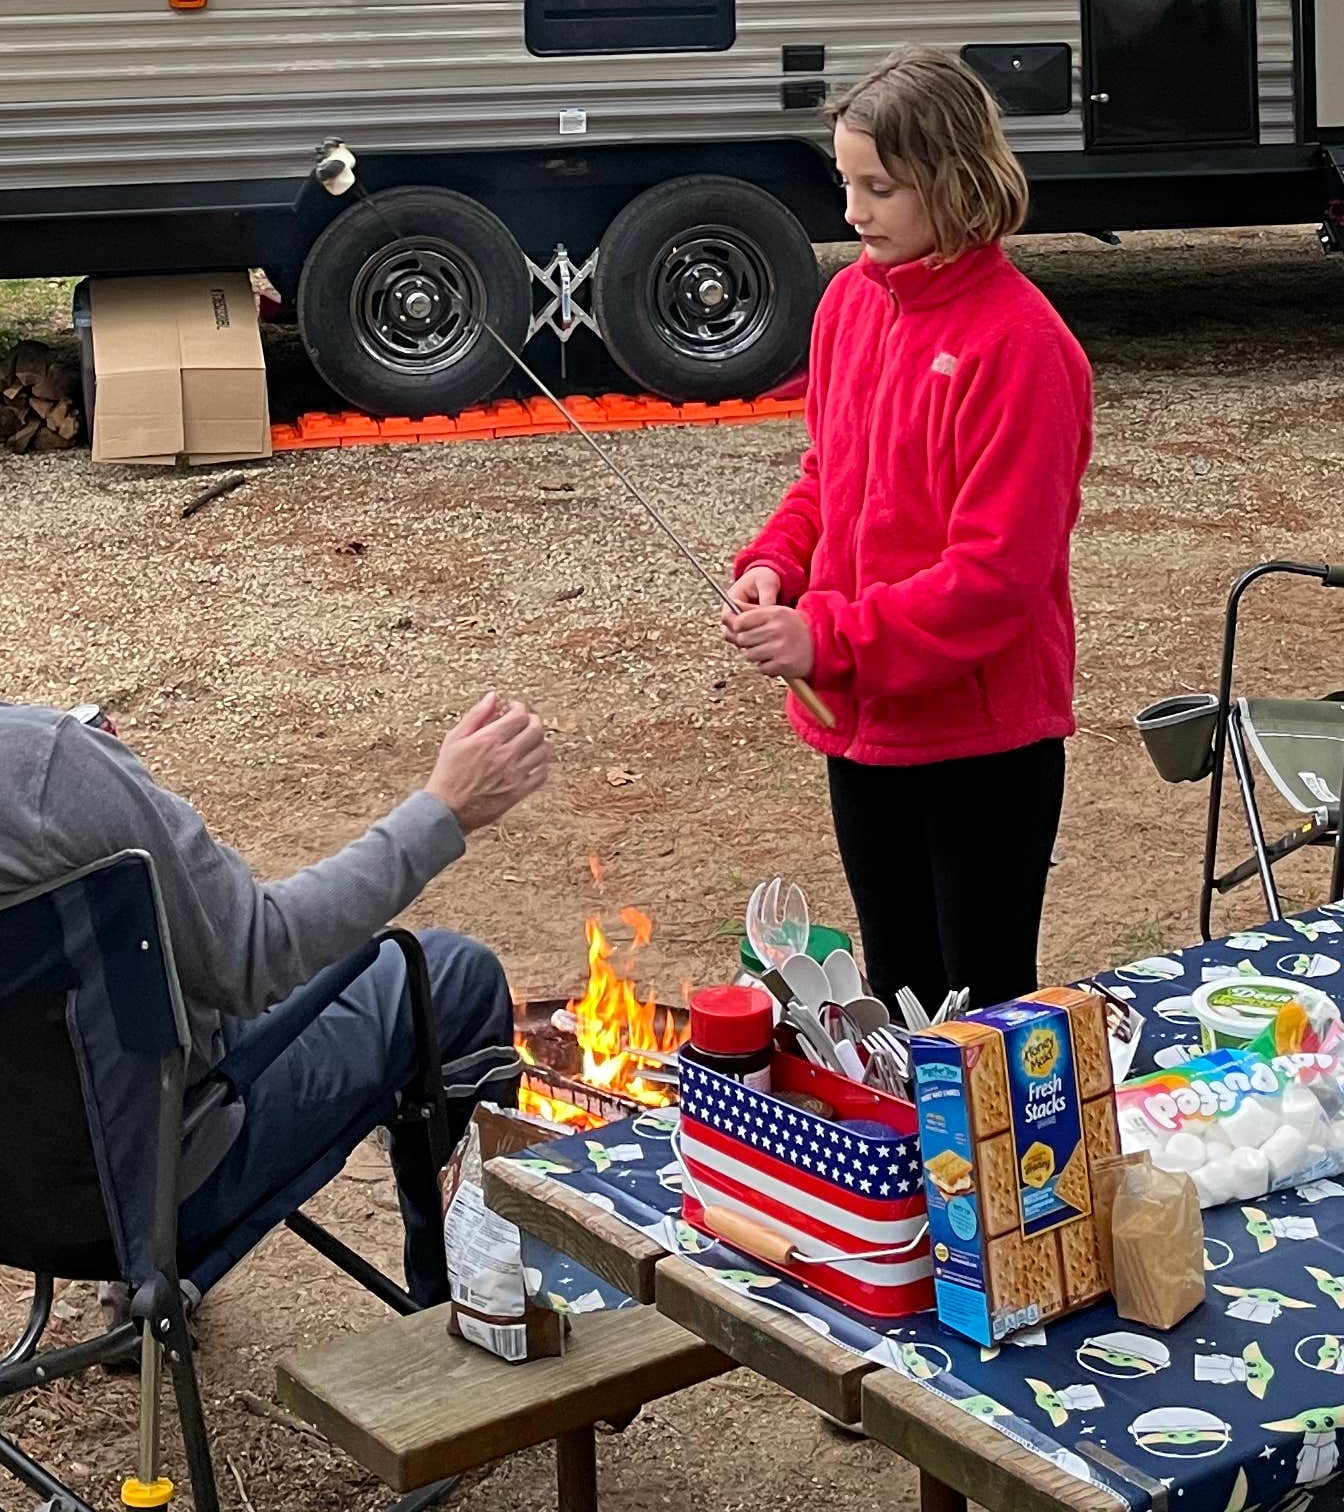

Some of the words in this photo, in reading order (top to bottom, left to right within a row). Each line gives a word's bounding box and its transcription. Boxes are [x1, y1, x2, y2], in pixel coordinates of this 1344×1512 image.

[1029, 1073, 1062, 1102] Fresh
[1143, 1062, 1280, 1131] Puffed
[1025, 1093, 1066, 1124] Stacks
